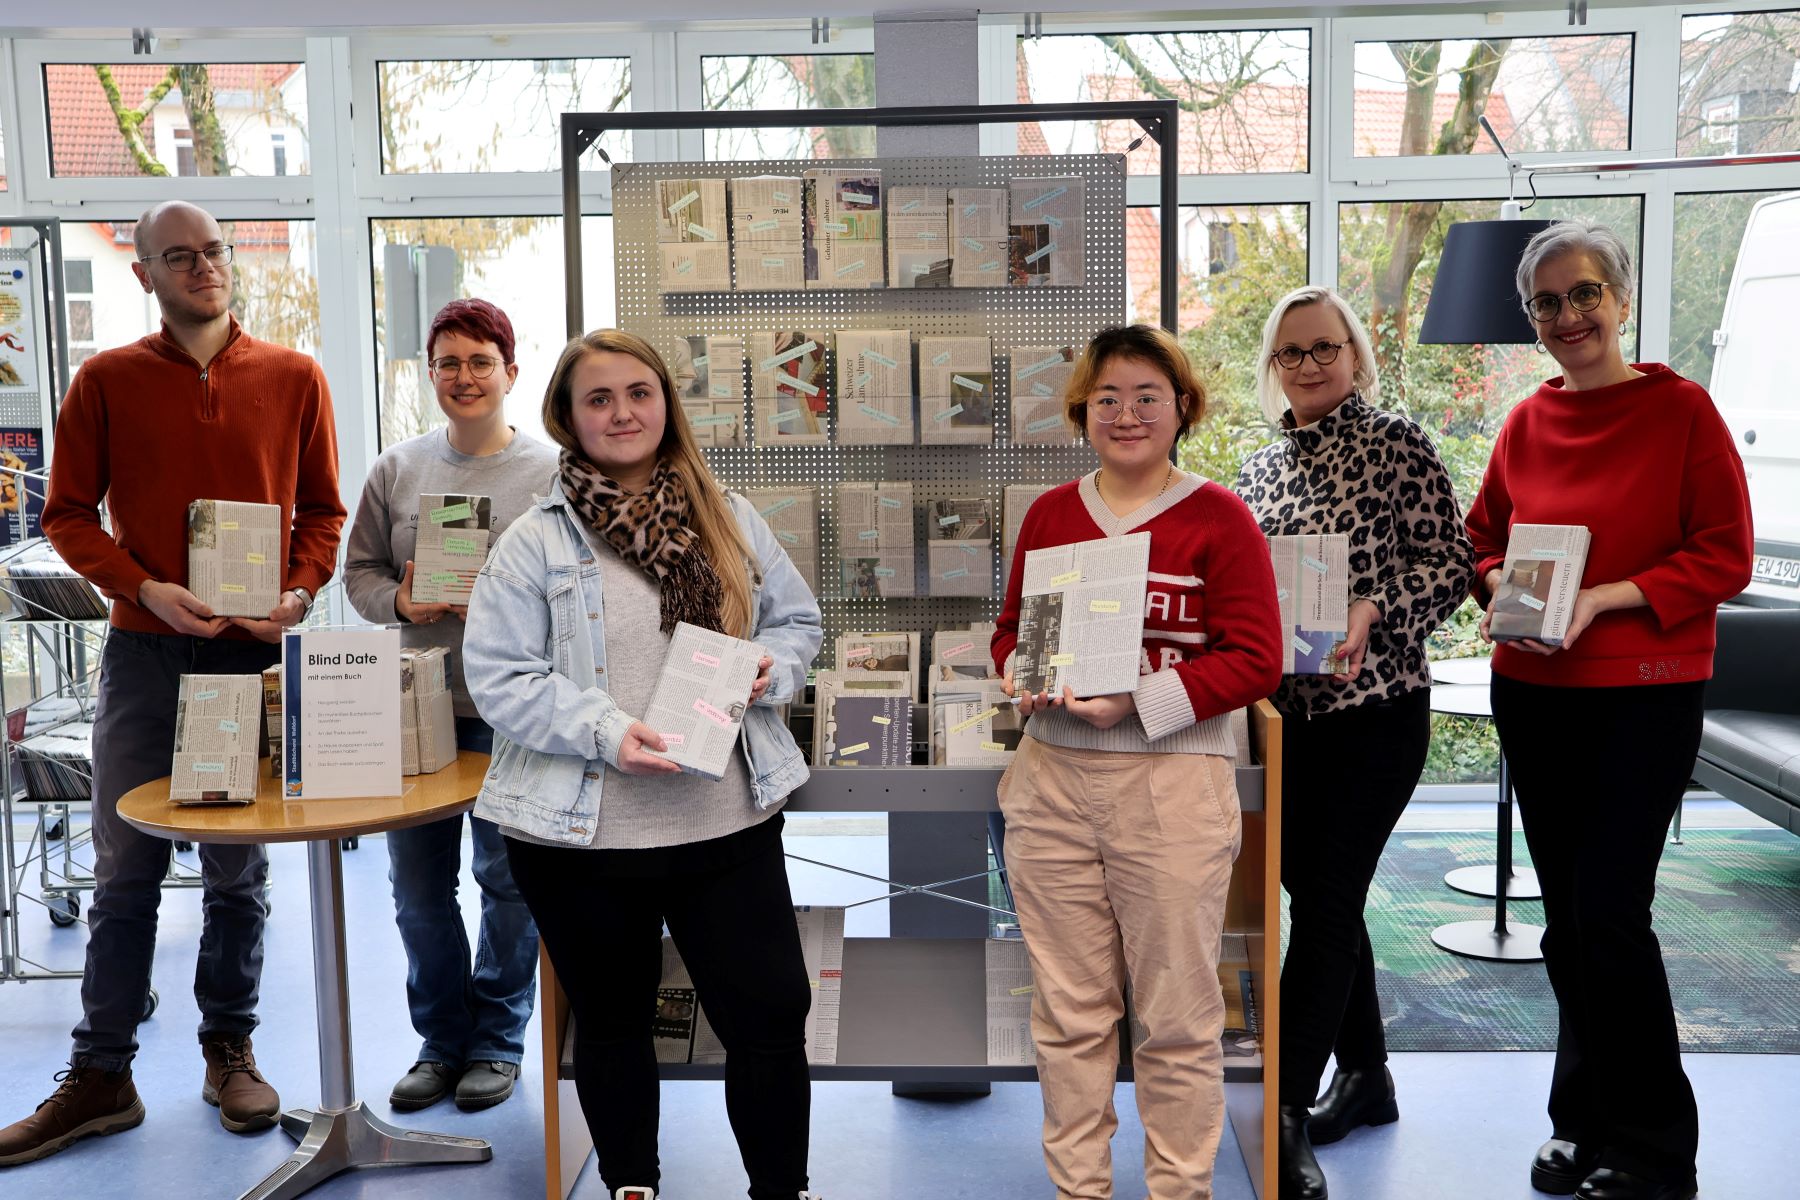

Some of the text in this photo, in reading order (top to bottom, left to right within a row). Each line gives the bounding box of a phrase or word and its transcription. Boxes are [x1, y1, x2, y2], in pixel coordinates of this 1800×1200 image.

[846, 358, 854, 400] Schweizer
[857, 353, 866, 404] Lanahme
[1774, 560, 1799, 579] 190
[1551, 562, 1571, 637] günstig versteuern
[308, 653, 378, 666] Blind Date
